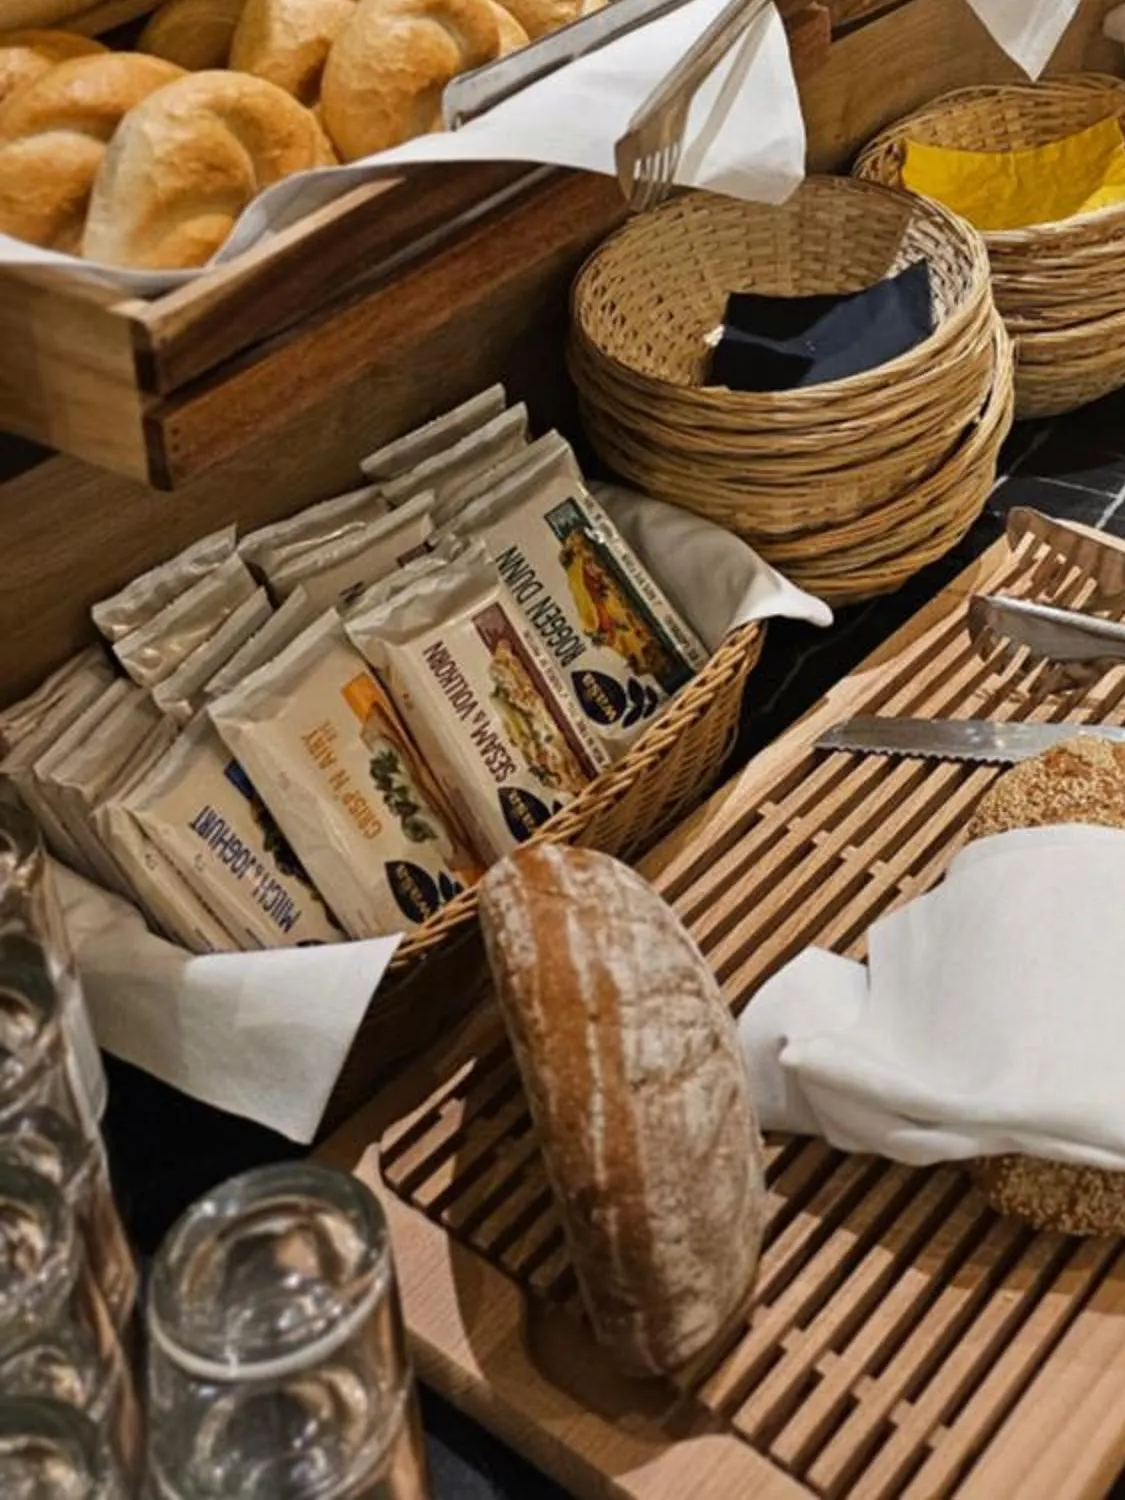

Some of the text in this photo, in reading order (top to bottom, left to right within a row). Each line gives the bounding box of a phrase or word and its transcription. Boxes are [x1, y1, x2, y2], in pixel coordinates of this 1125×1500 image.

[525, 596, 588, 668] ROGGEN
[422, 640, 479, 721] VOLLKORN
[301, 729, 337, 770] AIRY
[470, 720, 517, 783] SESAM
[188, 805, 257, 880] JOGHURT
[252, 872, 303, 934] MILCH
